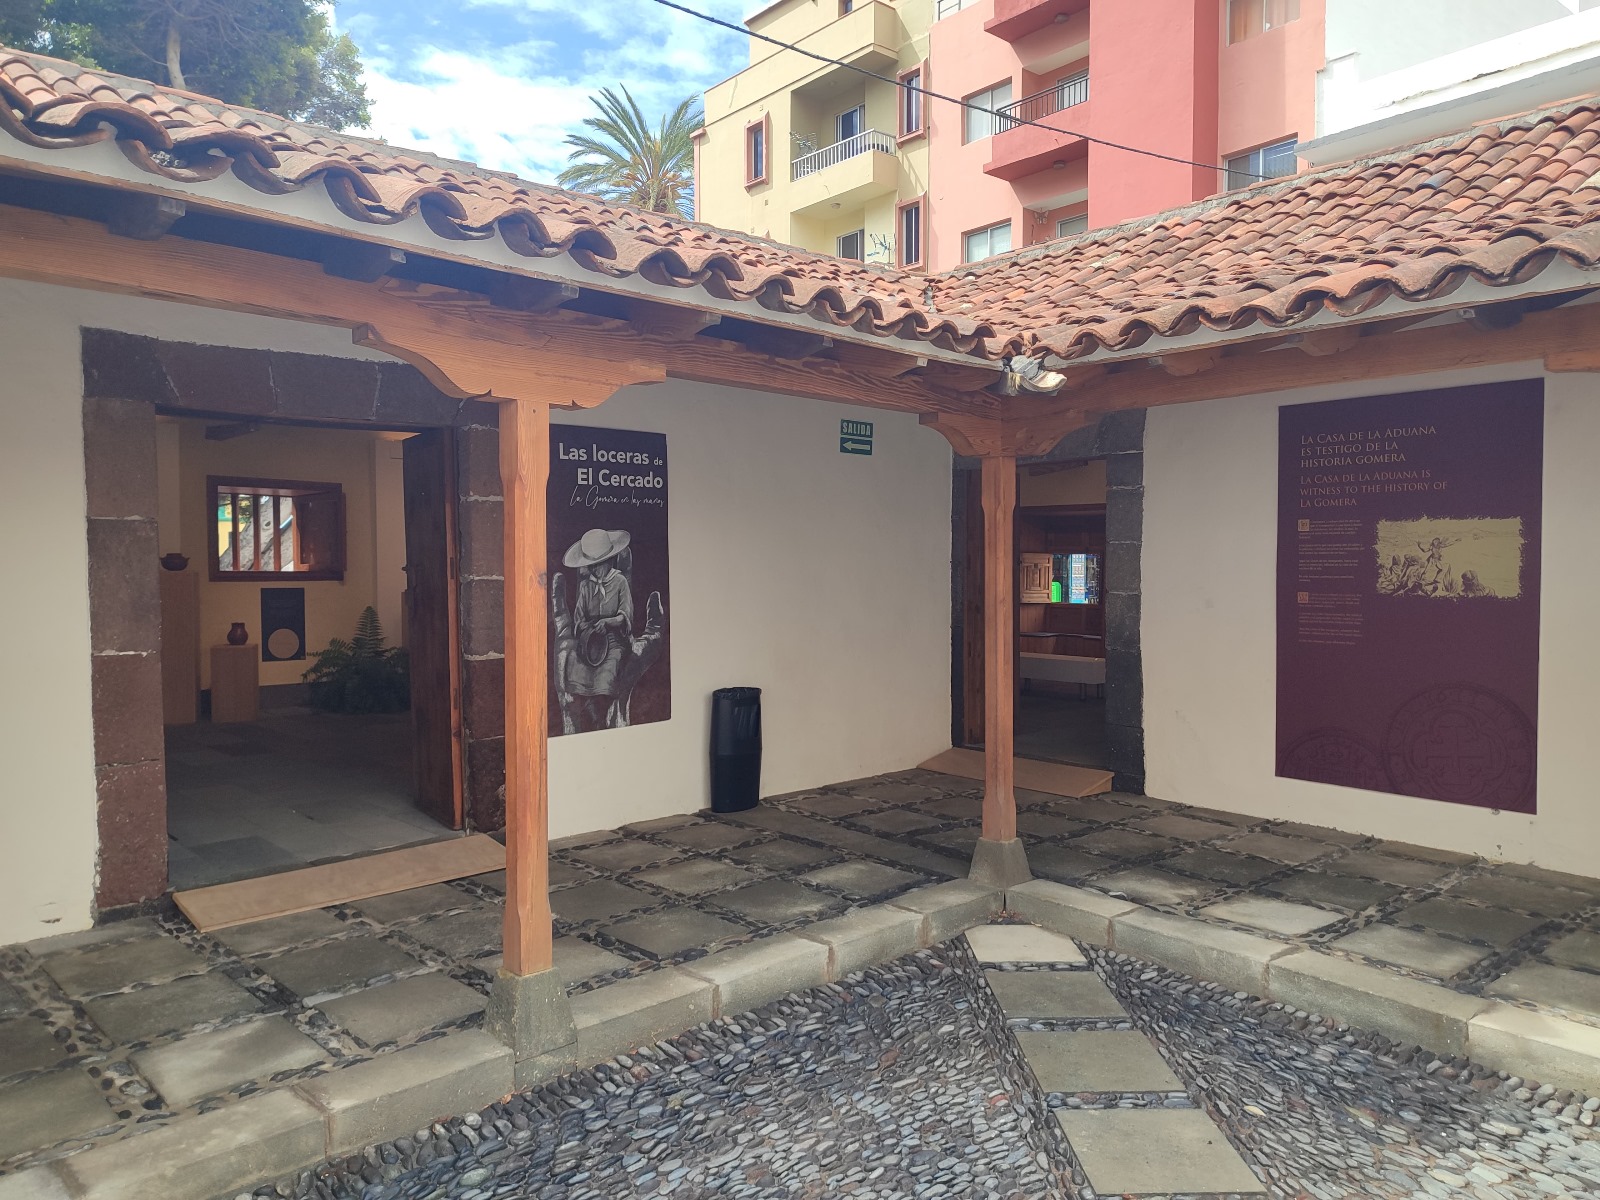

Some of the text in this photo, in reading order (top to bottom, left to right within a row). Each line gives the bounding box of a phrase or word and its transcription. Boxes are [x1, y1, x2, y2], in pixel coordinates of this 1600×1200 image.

[842, 422, 870, 435] SALIDA
[559, 443, 662, 466] Las loceras de
[1301, 441, 1398, 456] ES TESTIGO DE LA
[1301, 454, 1406, 468] HISTORIA GOMERA
[577, 468, 663, 488] El Cercado
[1300, 481, 1448, 496] WITNESS TO THE HISTORY OF
